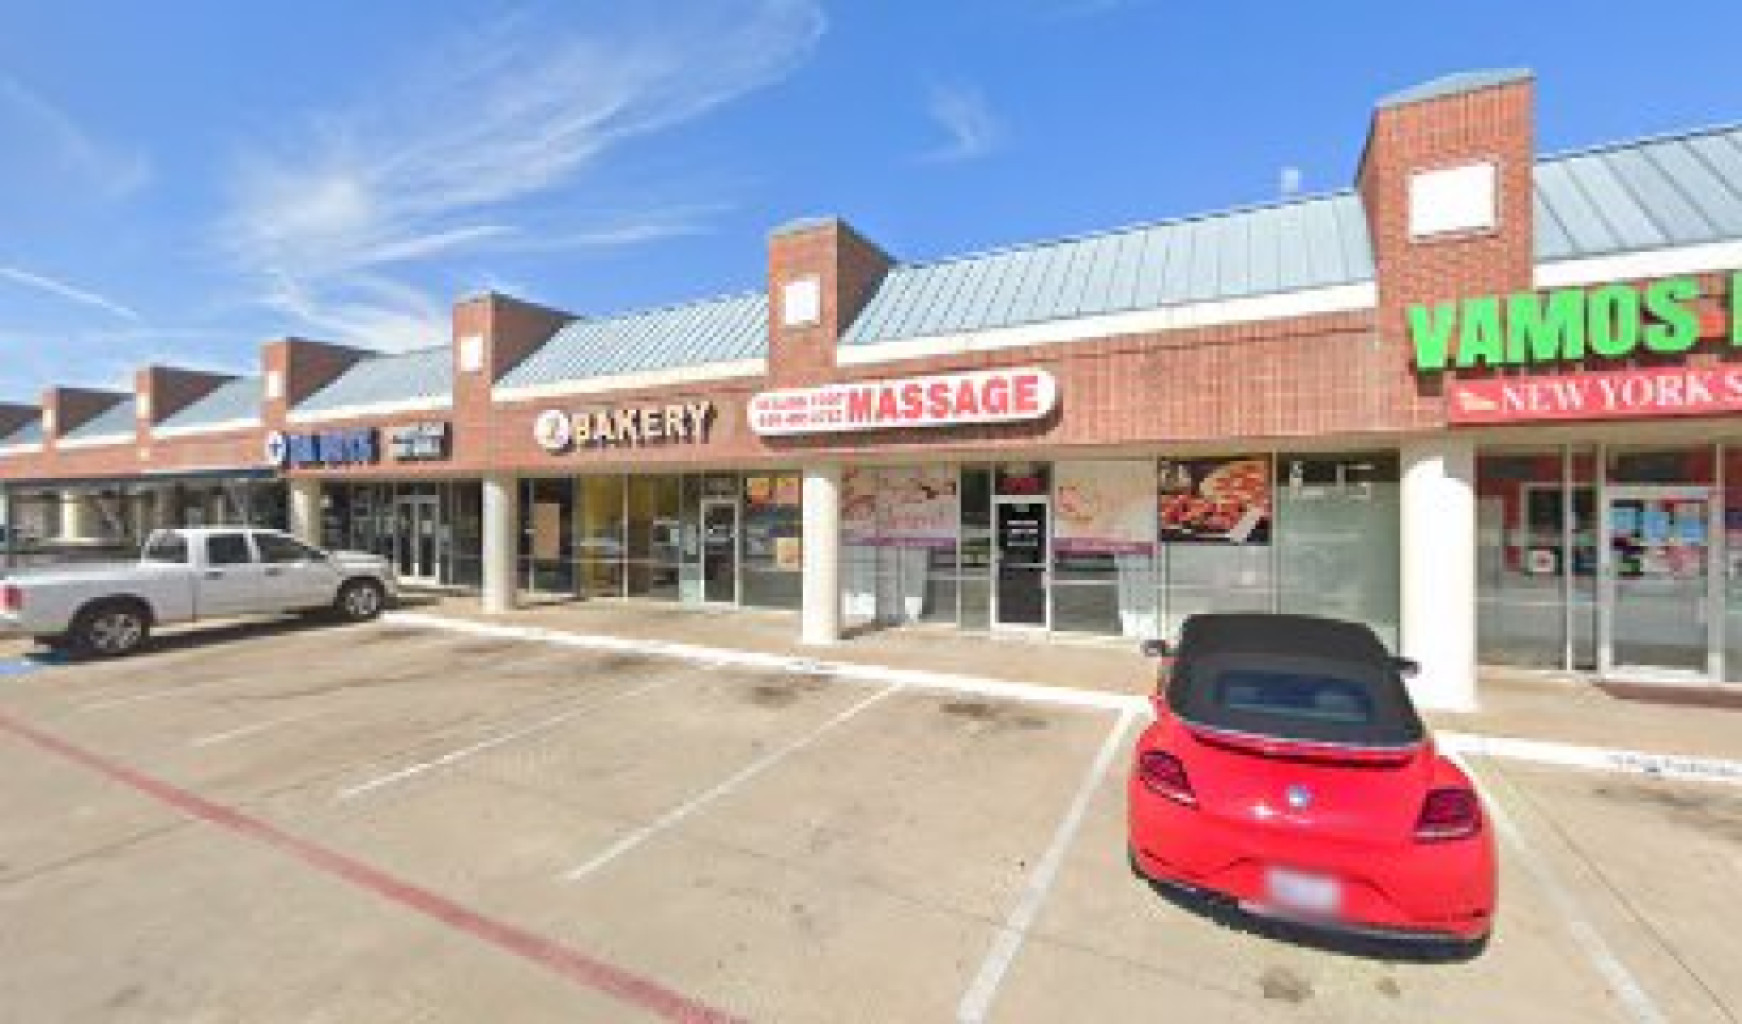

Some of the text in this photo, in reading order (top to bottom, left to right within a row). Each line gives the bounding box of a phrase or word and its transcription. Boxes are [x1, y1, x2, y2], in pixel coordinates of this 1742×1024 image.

[1409, 277, 1700, 369] VAMOS
[849, 375, 1039, 423] MASSAGE
[1502, 379, 1585, 411] NEW
[1599, 372, 1714, 410] YORK
[571, 400, 710, 442] BAKERY
